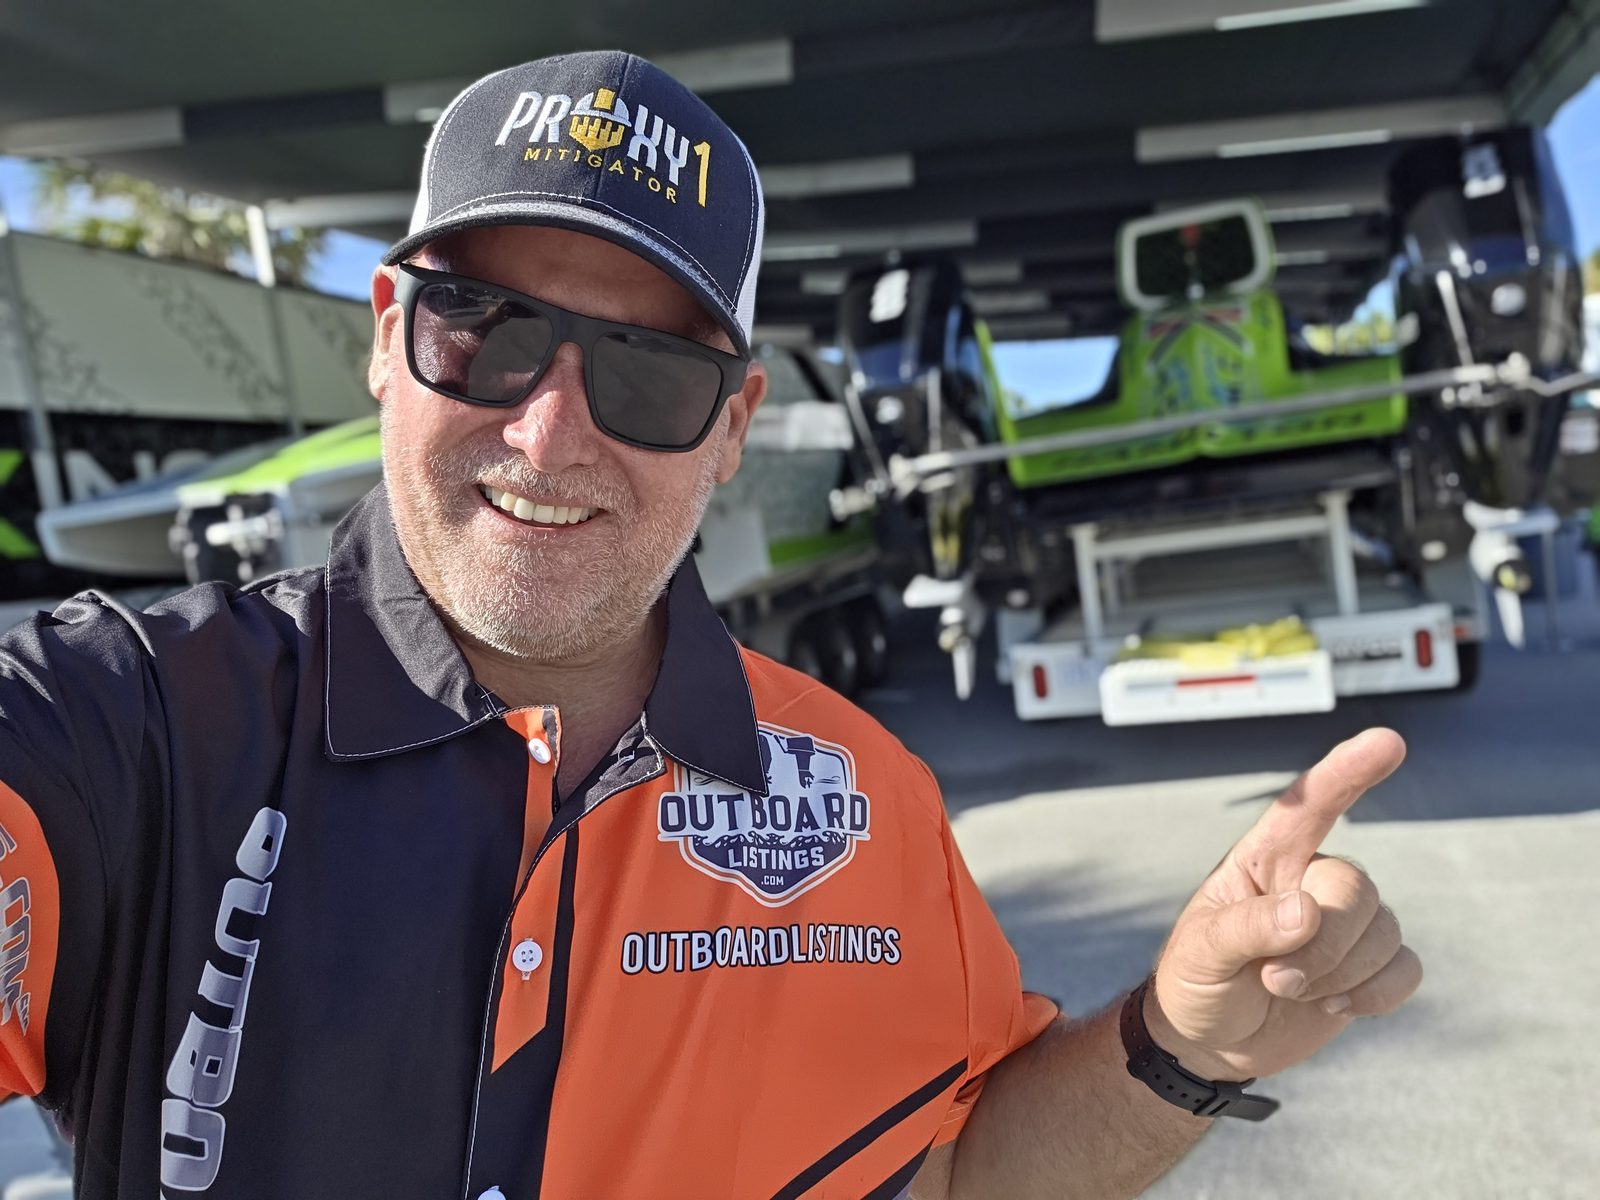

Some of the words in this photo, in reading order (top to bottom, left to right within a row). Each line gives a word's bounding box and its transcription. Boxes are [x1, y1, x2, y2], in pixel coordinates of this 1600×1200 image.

[524, 147, 676, 204] MITIGATOR
[660, 792, 868, 833] OUTBOARD
[728, 846, 824, 870] LISTINGS
[761, 875, 784, 886] .COM
[621, 923, 901, 974] OUTBOARDLISTINGS
[160, 806, 288, 1200] OUTBO
